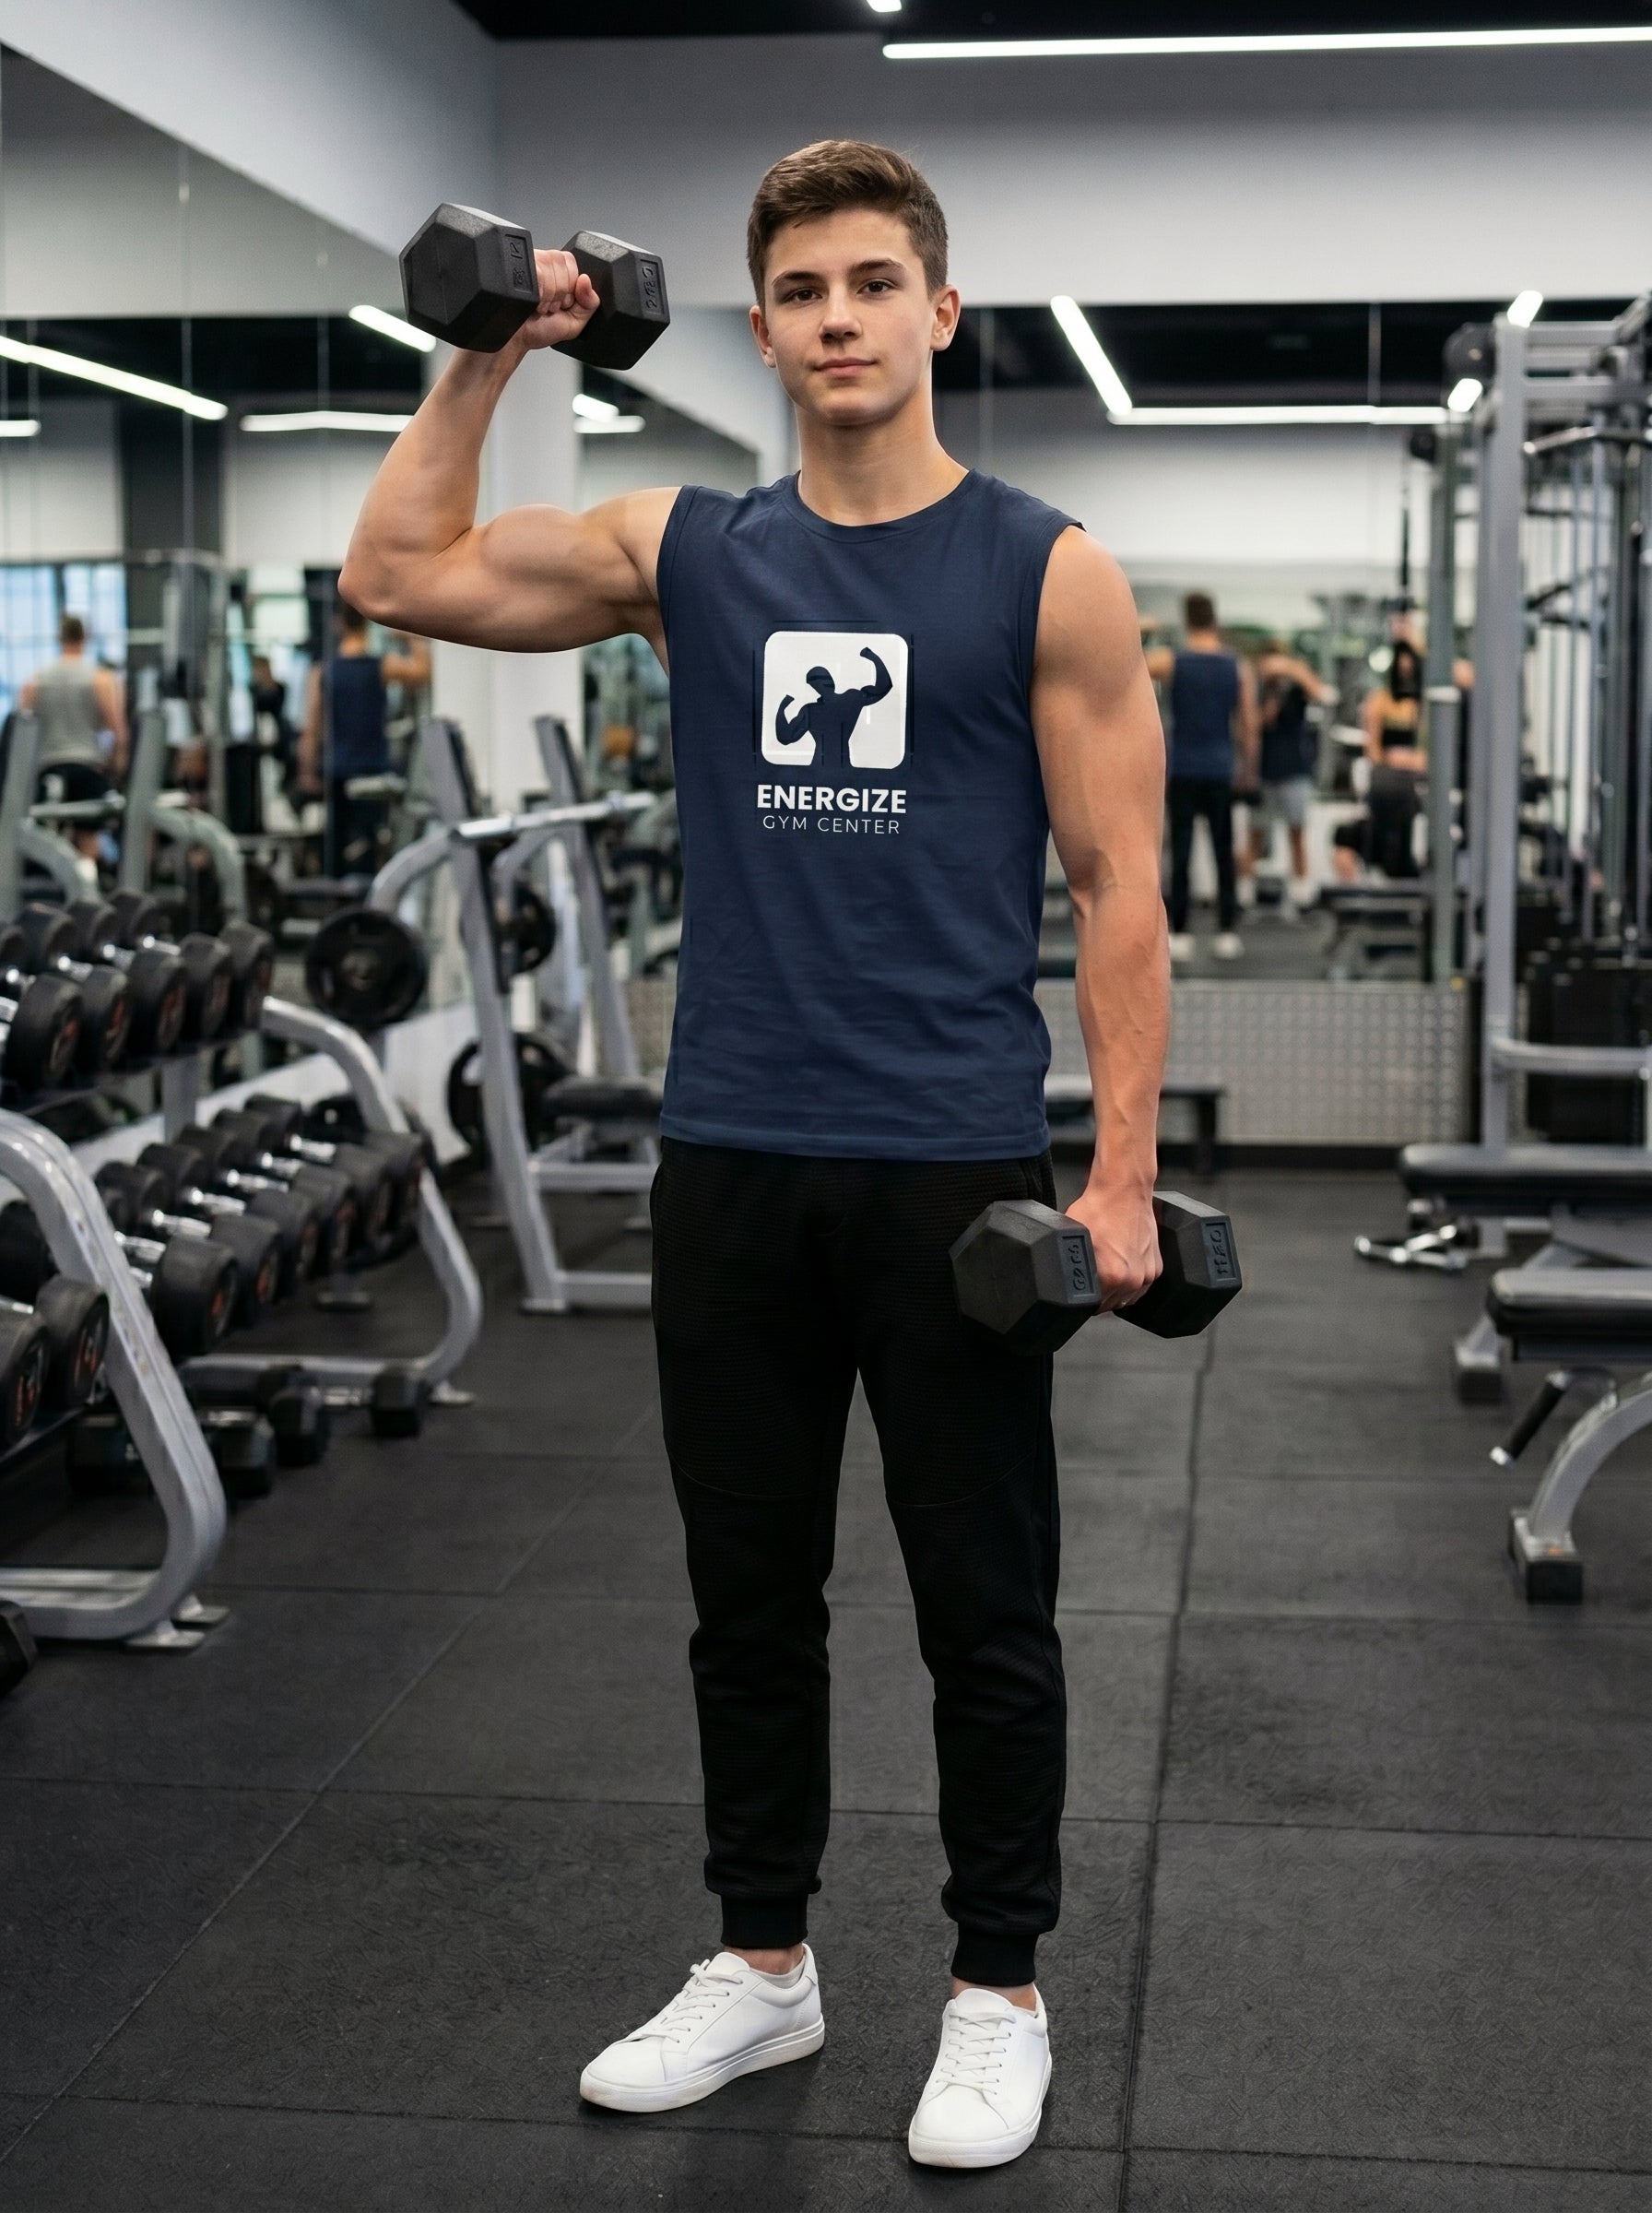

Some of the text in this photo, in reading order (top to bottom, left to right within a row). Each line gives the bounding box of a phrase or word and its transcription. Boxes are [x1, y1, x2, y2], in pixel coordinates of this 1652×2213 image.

[757, 784, 907, 813] ENERGIZE
[762, 815, 900, 834] GYM CENTER
